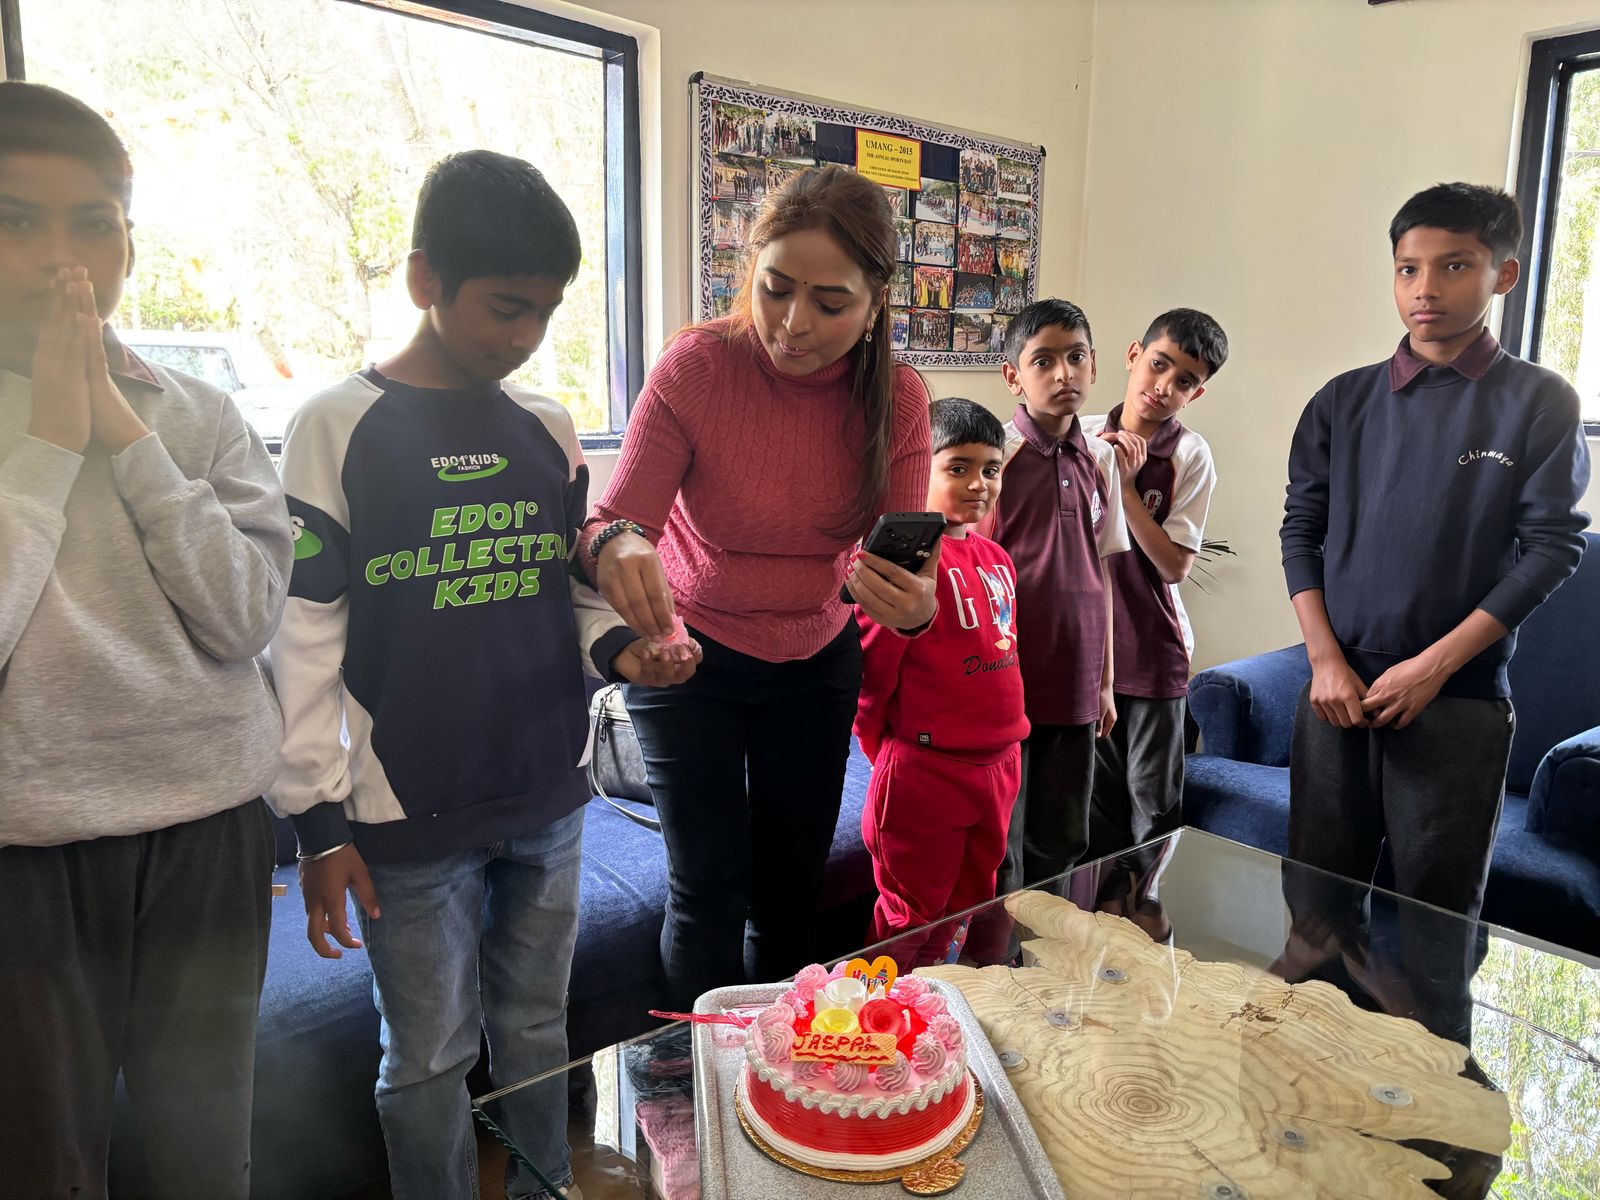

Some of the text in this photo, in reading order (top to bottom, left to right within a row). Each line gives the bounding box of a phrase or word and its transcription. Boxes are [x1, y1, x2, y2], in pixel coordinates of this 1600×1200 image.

[865, 140, 893, 152] UMANG
[899, 145, 913, 155] 2015
[1458, 450, 1514, 466] Chinmaya
[433, 568, 540, 609] KIDS
[852, 969, 888, 991] HAPPY
